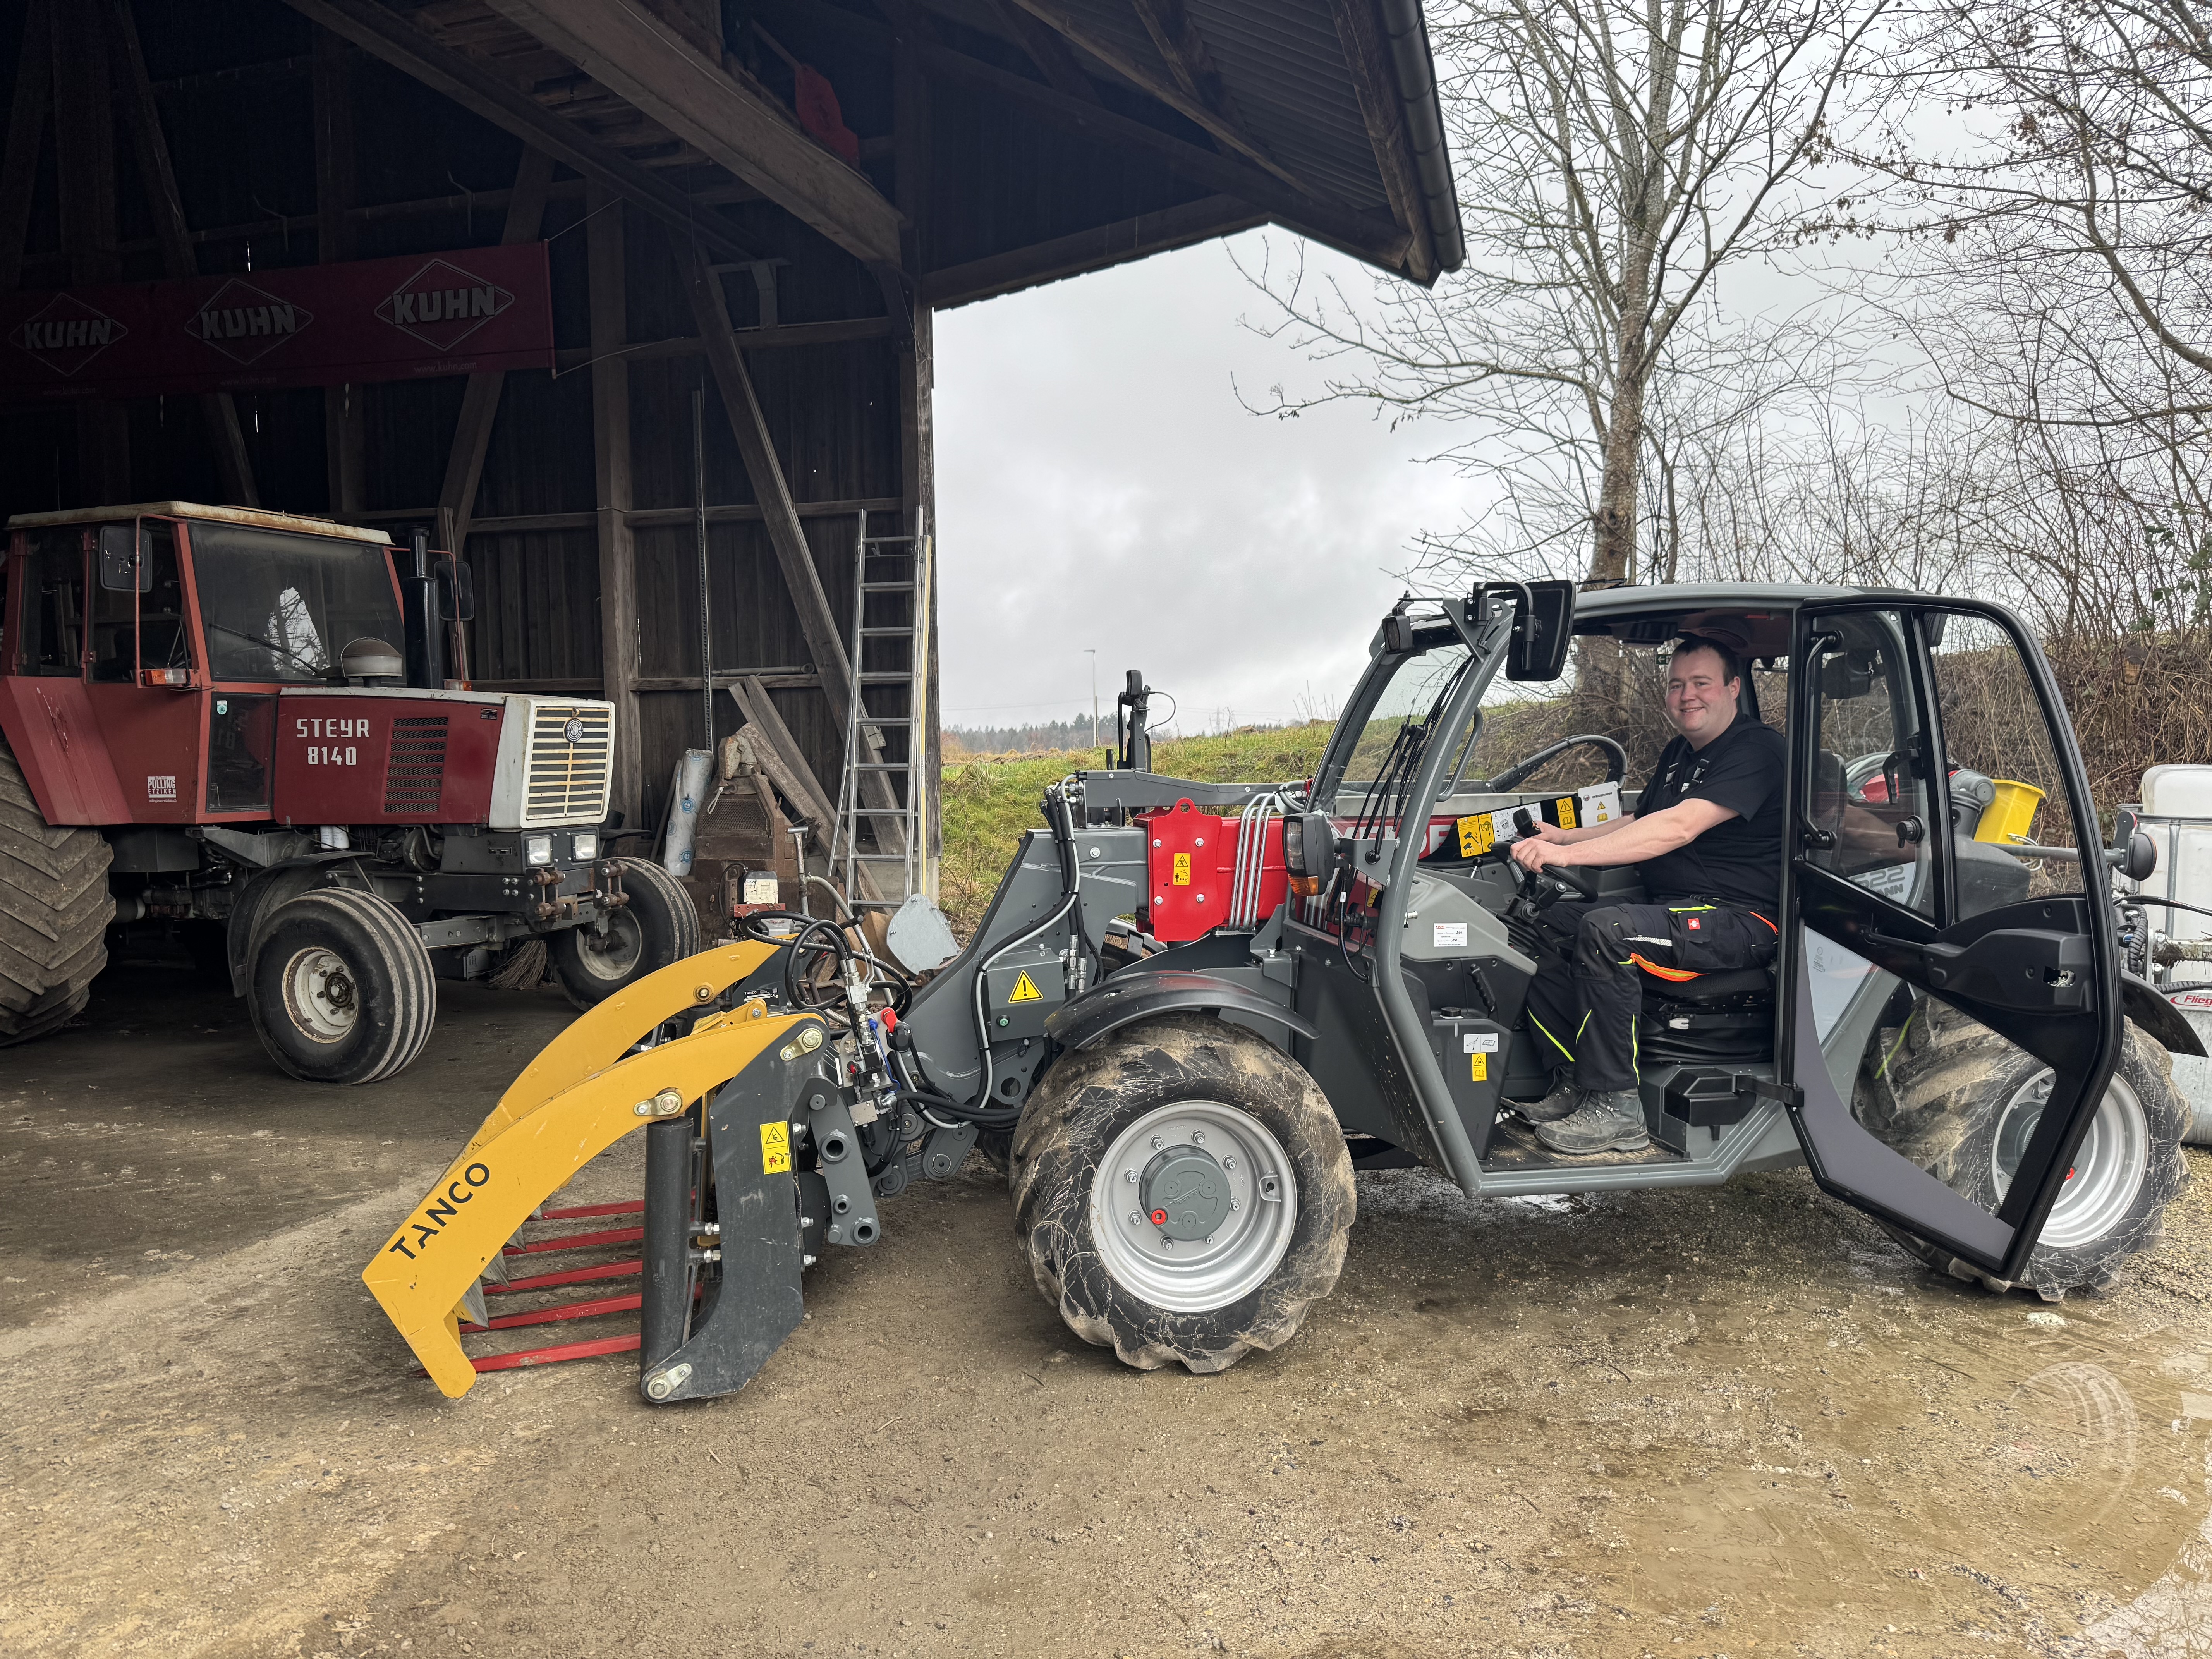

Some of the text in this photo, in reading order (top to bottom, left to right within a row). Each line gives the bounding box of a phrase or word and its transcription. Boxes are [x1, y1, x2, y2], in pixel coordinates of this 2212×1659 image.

[392, 285, 495, 325] KUHN
[24, 318, 111, 349] KUHN
[200, 304, 295, 340] KUHN
[414, 361, 477, 373] www.kuhn.com
[297, 719, 369, 737] STEYR
[308, 747, 356, 765] 8140
[148, 780, 176, 789] PULLING
[389, 1163, 490, 1259] TANCO
